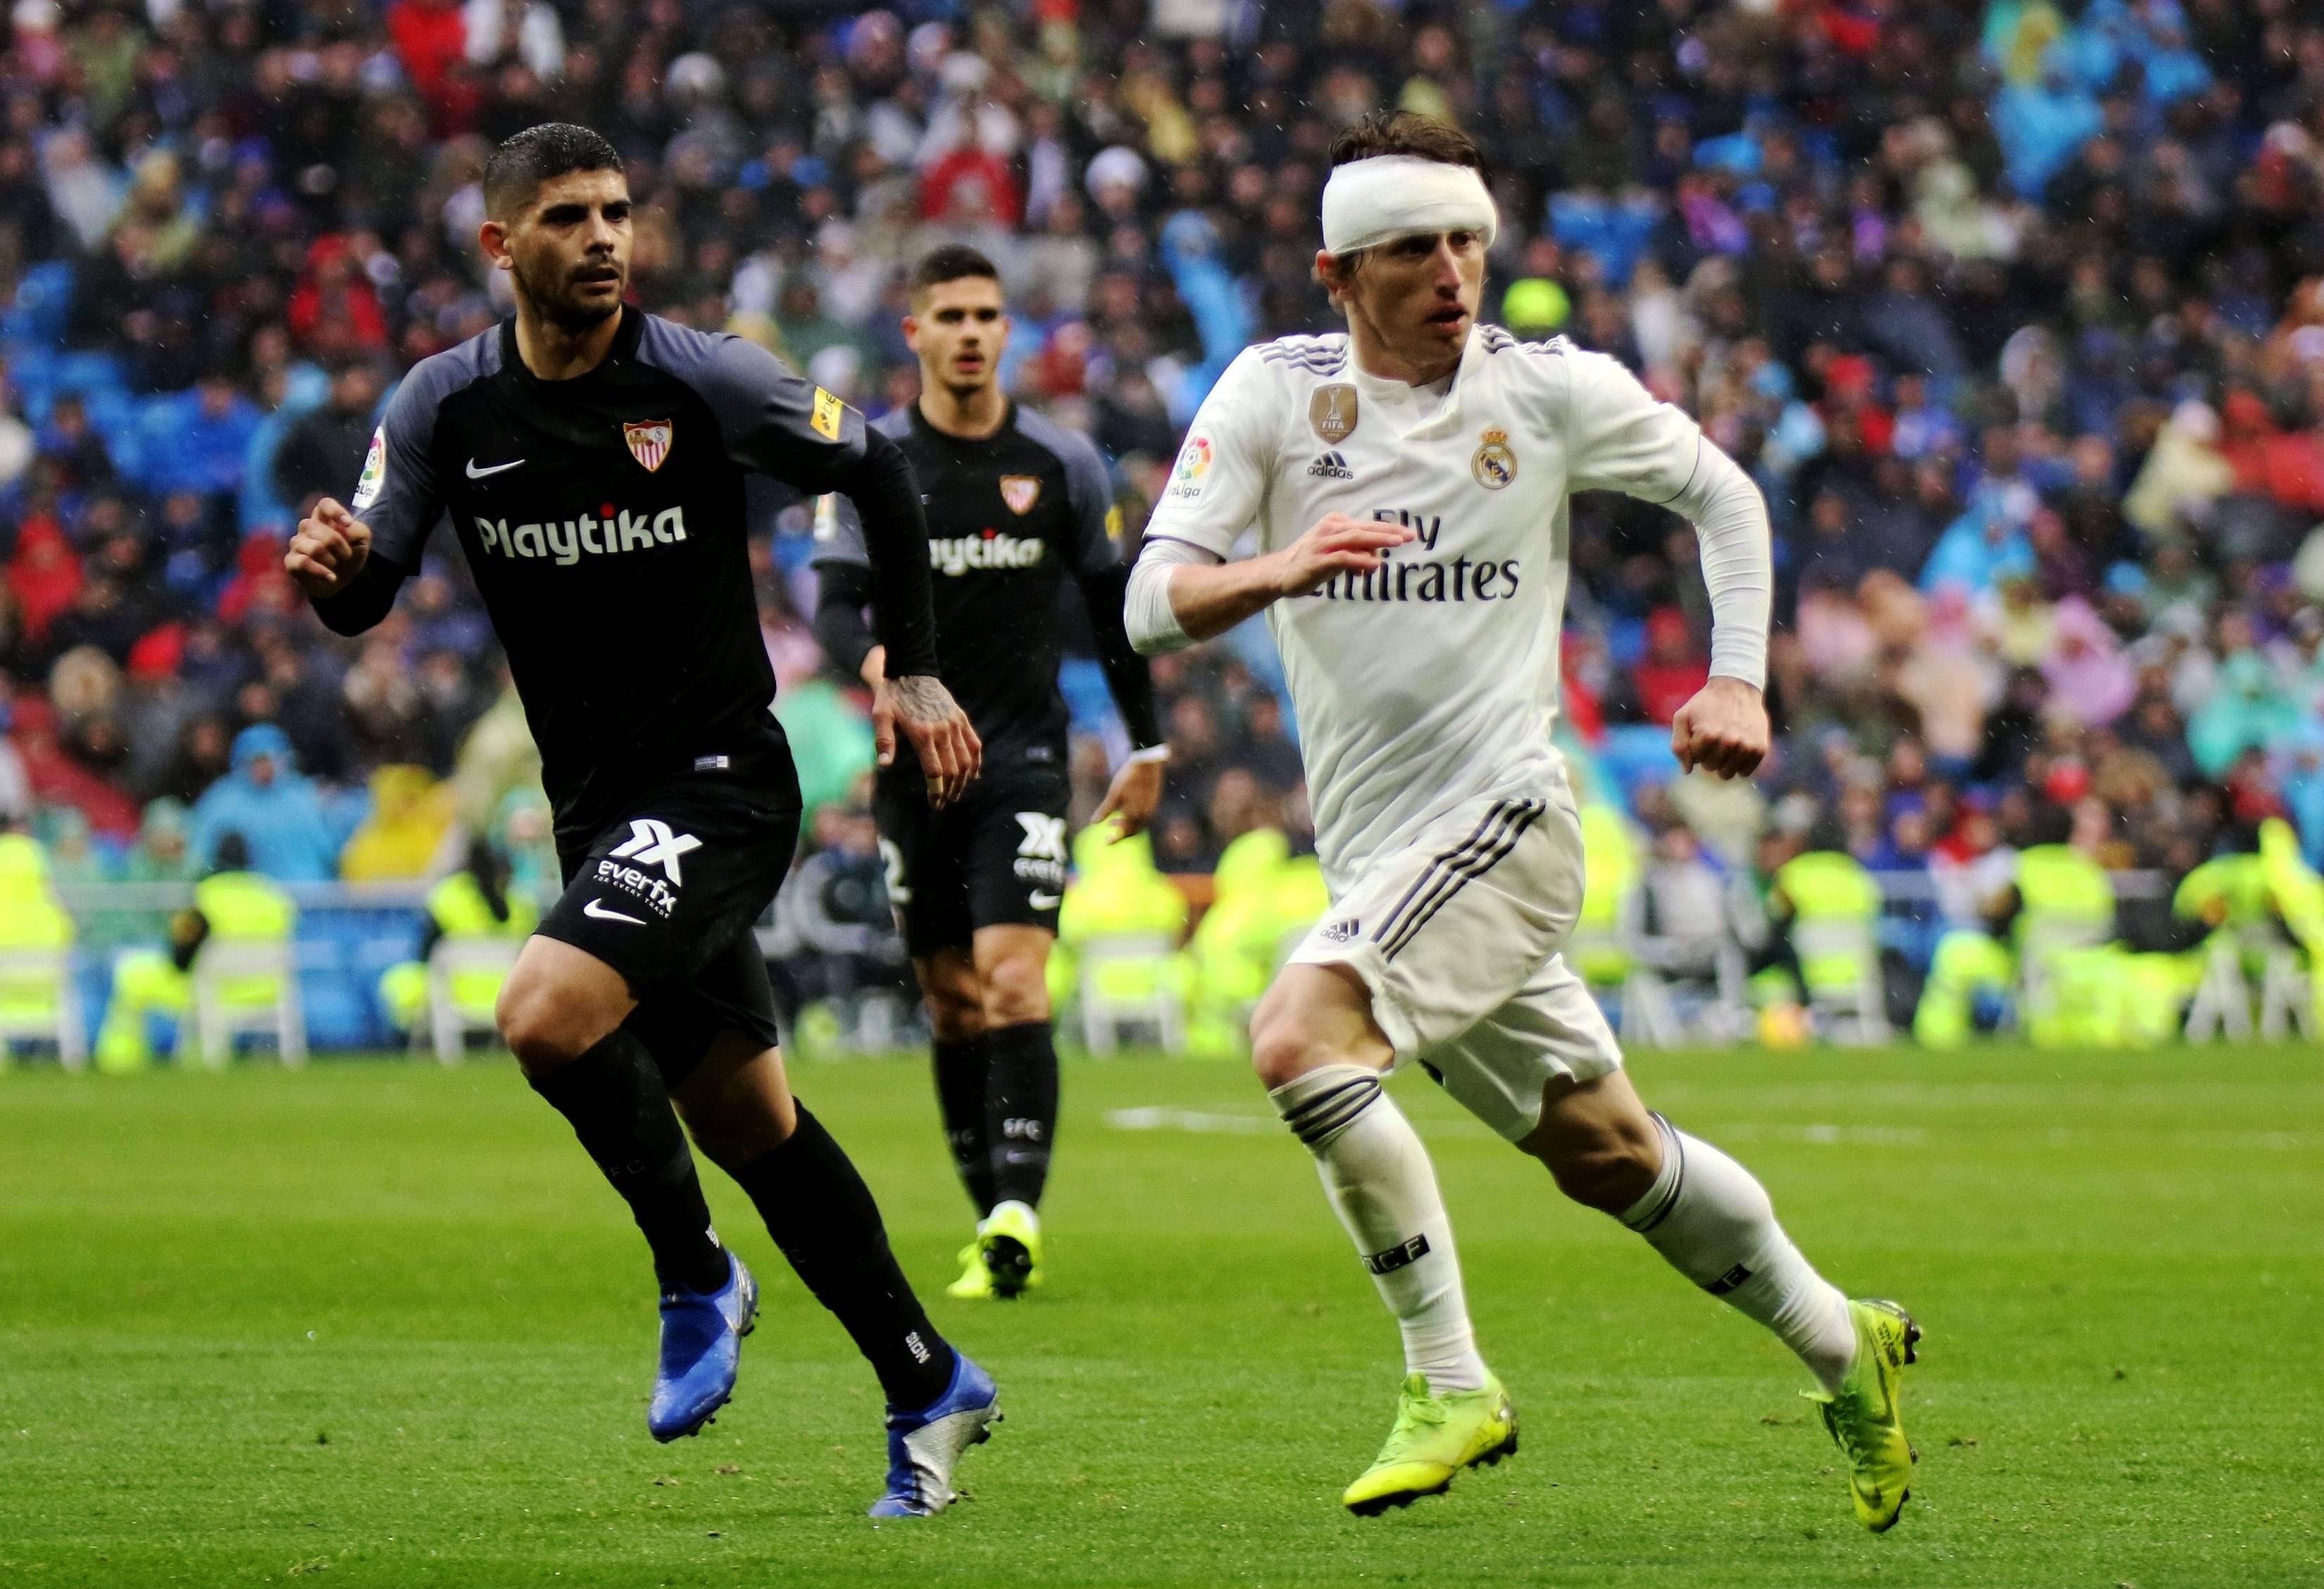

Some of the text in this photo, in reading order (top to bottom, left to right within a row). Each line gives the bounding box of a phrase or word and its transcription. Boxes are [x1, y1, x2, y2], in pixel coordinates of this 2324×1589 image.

[1321, 421, 1344, 429] FIFA
[1307, 465, 1354, 479] adidas
[473, 502, 687, 565] Playtika
[1307, 548, 1520, 602] mirates
[598, 860, 677, 912] everfx
[613, 880, 642, 898] EVERY
[1320, 929, 1350, 943] adid
